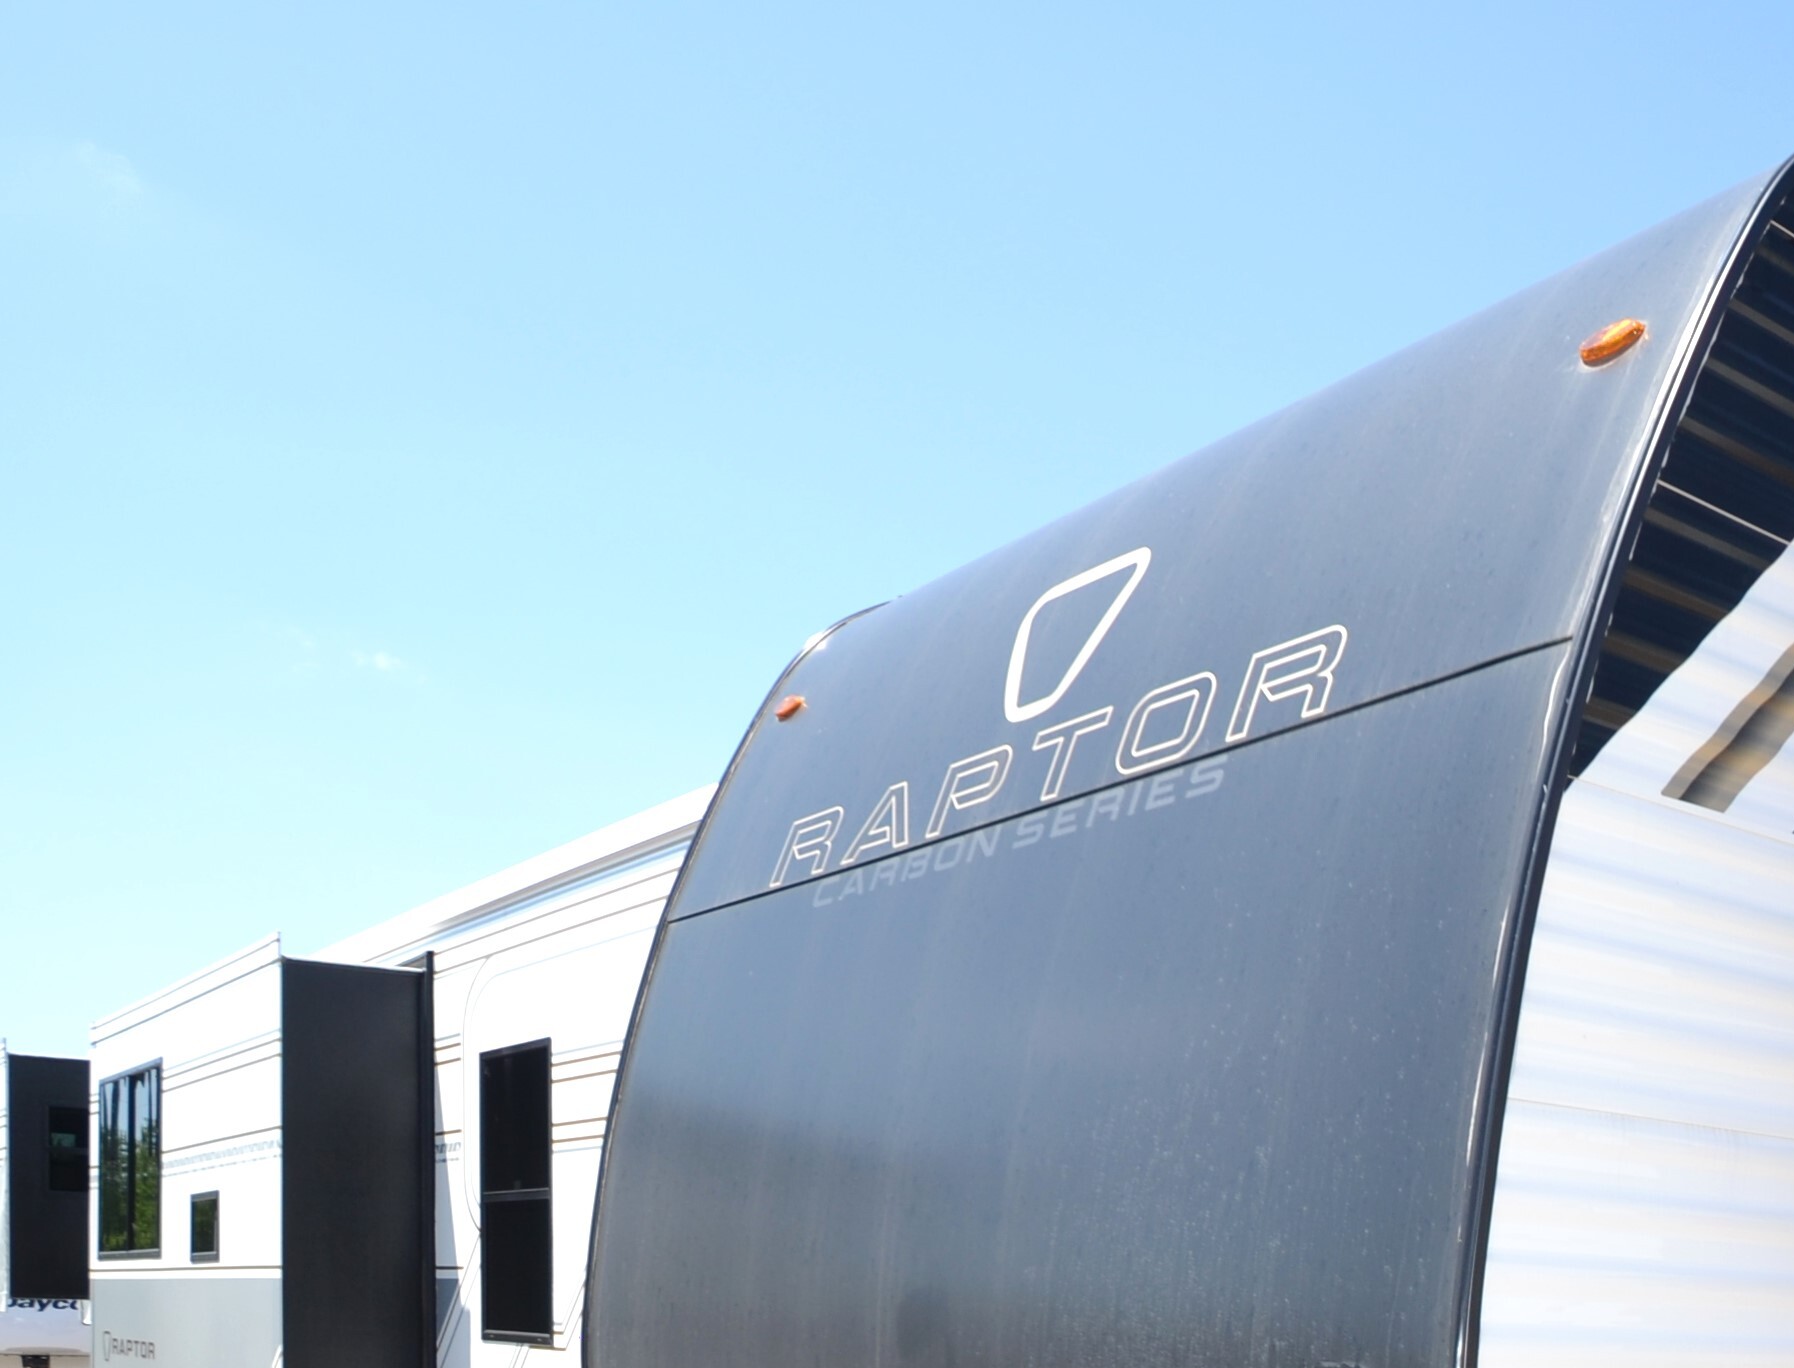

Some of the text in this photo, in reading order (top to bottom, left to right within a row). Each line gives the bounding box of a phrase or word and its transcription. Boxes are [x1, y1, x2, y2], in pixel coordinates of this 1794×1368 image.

[768, 624, 1348, 889] RAPTOR
[811, 754, 1230, 908] CARBON SERIES
[111, 1337, 156, 1360] RAPTOR
